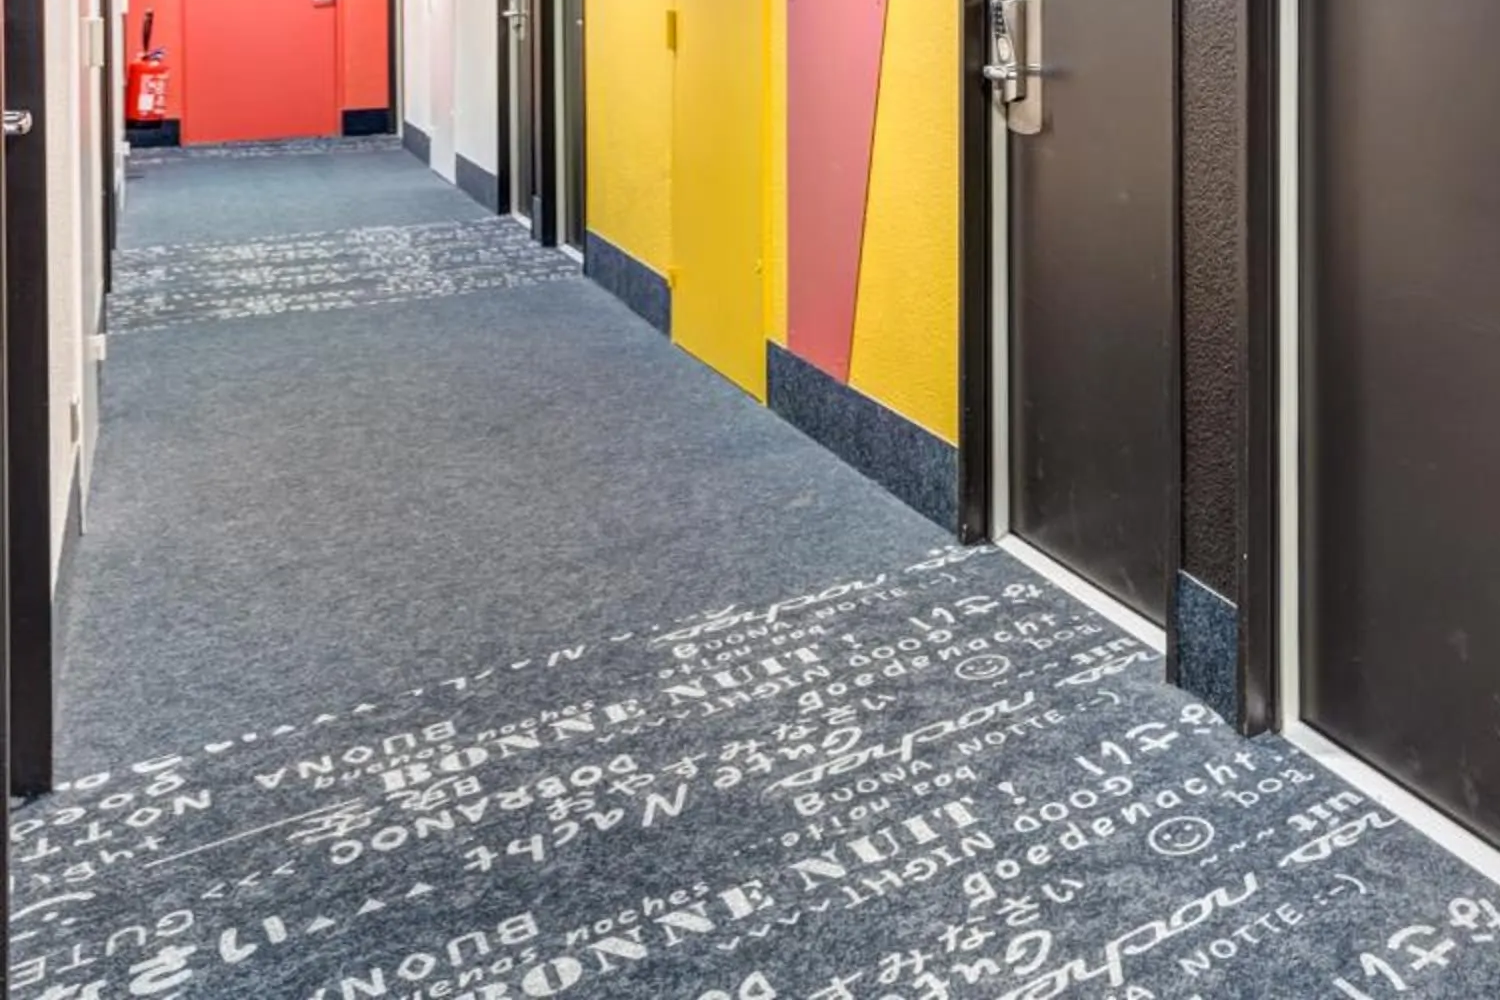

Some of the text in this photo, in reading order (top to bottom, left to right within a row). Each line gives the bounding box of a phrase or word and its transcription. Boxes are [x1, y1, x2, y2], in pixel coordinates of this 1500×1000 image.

[255, 720, 456, 789] BUONA
[380, 698, 646, 792] BONNE
[662, 643, 821, 705] NUIT
[477, 700, 594, 742] noches
[794, 760, 932, 816] BUONA
[958, 709, 1066, 756] NOTTE
[331, 754, 638, 865] DOBRANOC
[464, 726, 862, 872] Gute Nacht
[788, 796, 979, 891] NUIT
[841, 775, 1133, 909] GOOD NIGHT
[565, 881, 709, 946] noches
[1179, 903, 1304, 979] NOTTE
